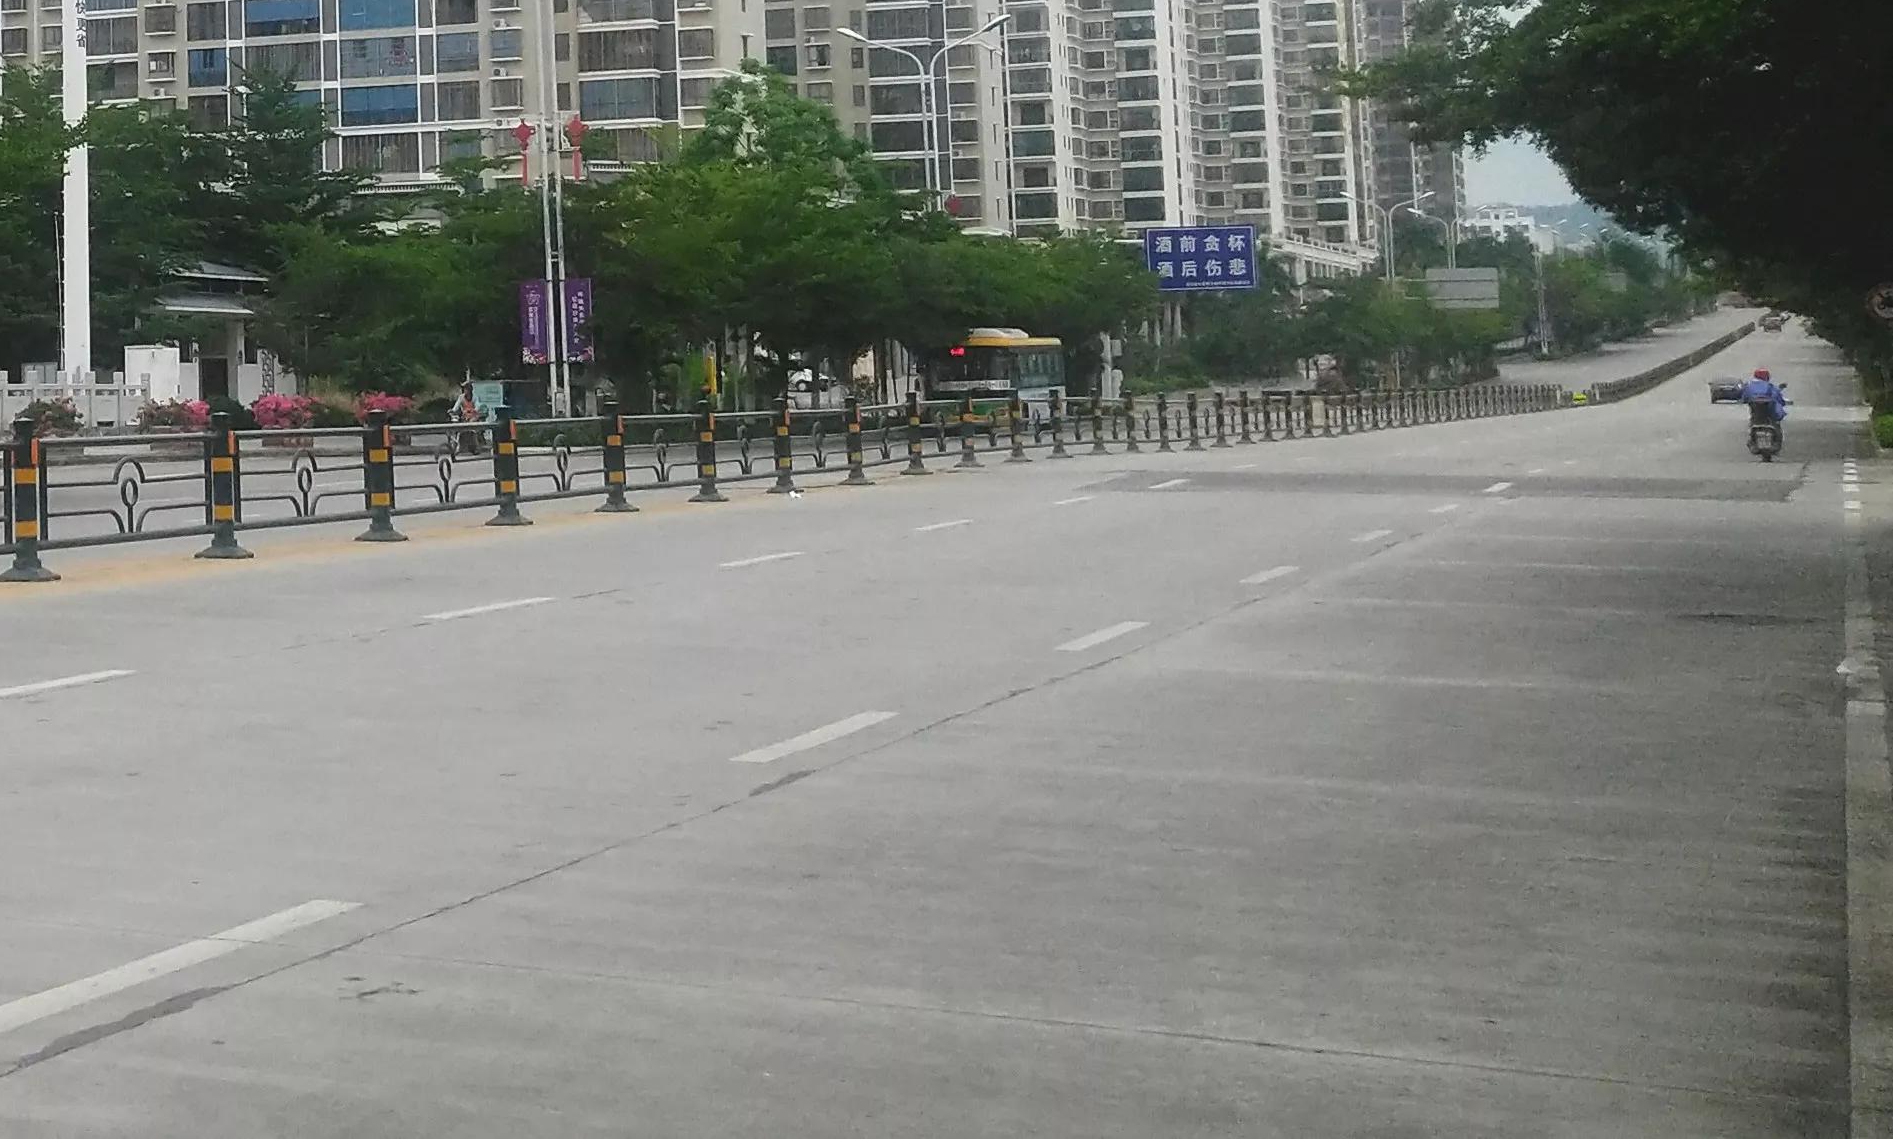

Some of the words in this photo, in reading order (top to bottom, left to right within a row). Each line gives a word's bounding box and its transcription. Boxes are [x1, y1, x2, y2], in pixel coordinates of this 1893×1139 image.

[1155, 234, 1246, 253] 酒前贪杯
[1157, 258, 1247, 278] 酒后伤悲
